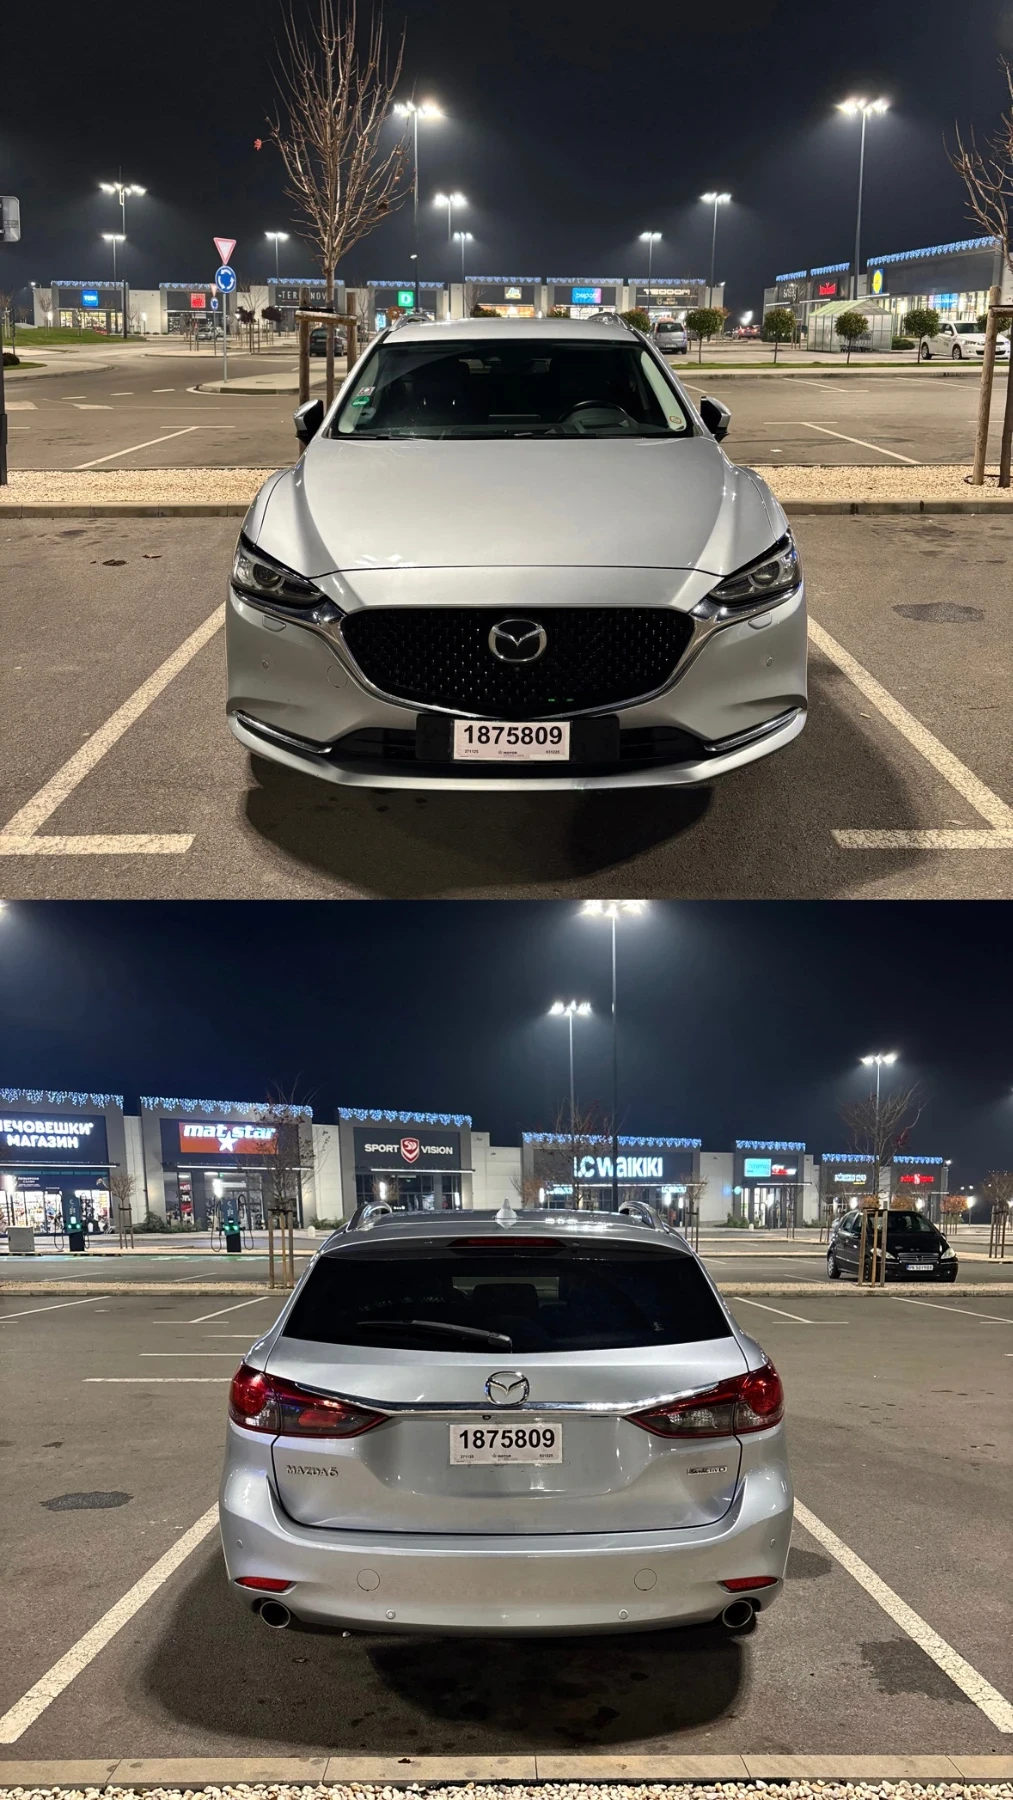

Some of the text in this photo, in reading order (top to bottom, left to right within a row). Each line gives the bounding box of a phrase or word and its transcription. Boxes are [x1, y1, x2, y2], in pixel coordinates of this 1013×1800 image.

[463, 725, 563, 745] 1875809
[0, 1119, 91, 1135] ЕЧОВЕШКИ
[183, 1124, 277, 1139] mat star
[6, 1133, 79, 1149] МАГАЗИН
[364, 1143, 454, 1155] SPORT VISION
[459, 1428, 555, 1449] 1875809
